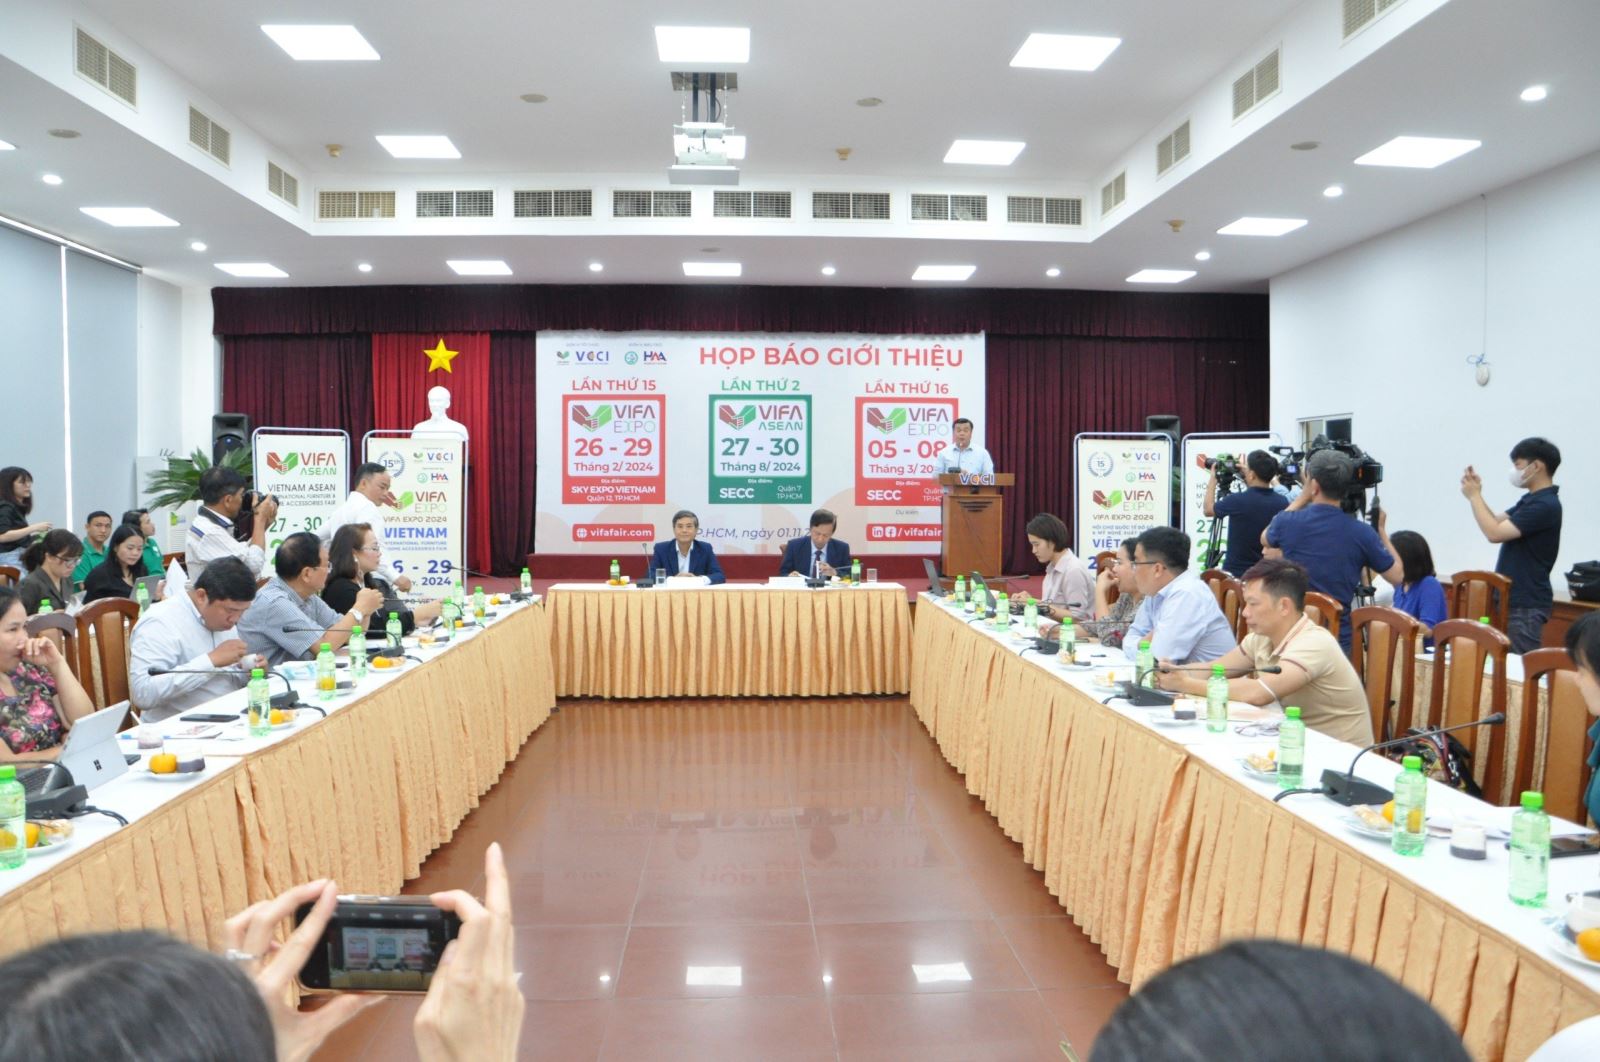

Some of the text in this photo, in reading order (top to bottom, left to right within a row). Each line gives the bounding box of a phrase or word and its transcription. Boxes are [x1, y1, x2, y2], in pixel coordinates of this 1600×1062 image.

[576, 351, 609, 361] VCCI
[700, 343, 963, 371] HỌP BÁO GIỚI THIỆU
[607, 377, 639, 391] THỨ
[642, 380, 656, 391] 15
[756, 378, 788, 391] THỨ
[792, 380, 800, 391] 2
[900, 380, 931, 393] THỨ
[934, 382, 949, 394] 16
[614, 405, 656, 419] VIFA
[758, 405, 803, 420] VIFA
[908, 408, 949, 422] VIFA
[613, 421, 656, 433] EXPO
[758, 422, 804, 431] ASEAN
[908, 423, 949, 436] EXPO
[574, 438, 604, 457] 26
[624, 438, 652, 457] 29
[721, 438, 750, 456] 27
[769, 438, 799, 456] 30
[868, 440, 897, 459] 05
[301, 452, 337, 466] VIFA
[300, 467, 337, 475] ASEAN
[575, 462, 610, 473] Tháng
[626, 462, 654, 472] 2024
[720, 462, 756, 473] Tháng
[773, 462, 801, 472] 2024
[869, 464, 905, 475] Tháng
[920, 465, 934, 474] 20
[960, 473, 995, 485] VCCI
[268, 483, 336, 492] VIETNAM ASEAN
[571, 486, 656, 494] SKY EXPO VIETNAM
[719, 487, 755, 499] SECC
[415, 491, 447, 502] VIFA
[866, 489, 902, 501] SECC
[1123, 490, 1154, 501] VIFA
[384, 527, 448, 538] VIETNAM
[590, 528, 652, 537] vifafair.com
[742, 528, 774, 540] ngày
[427, 559, 452, 573] 29
[421, 577, 452, 586] 2024
